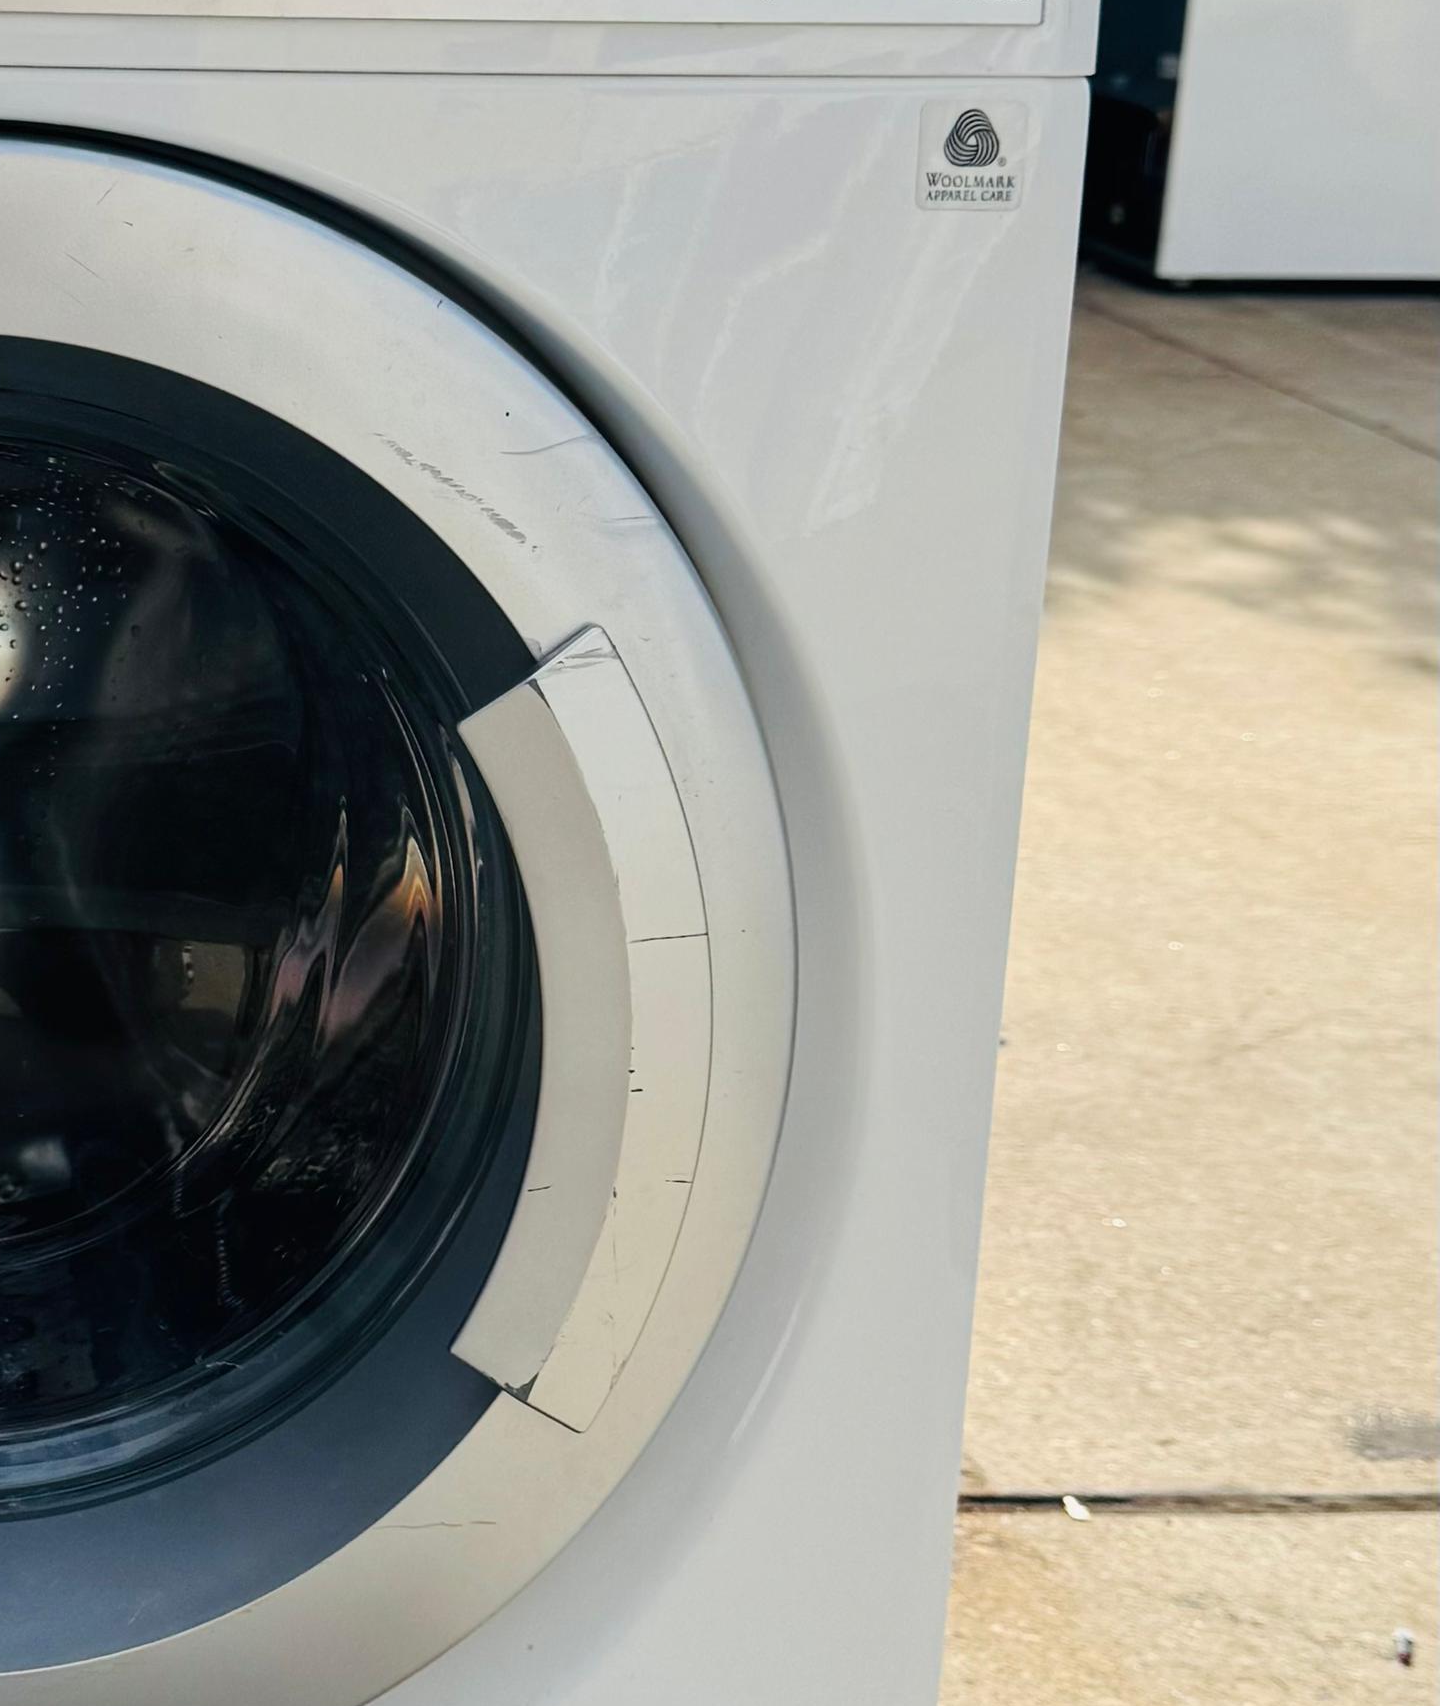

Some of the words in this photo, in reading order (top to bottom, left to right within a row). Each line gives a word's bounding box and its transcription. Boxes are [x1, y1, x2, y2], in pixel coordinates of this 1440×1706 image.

[926, 172, 1015, 188] WOOLMARK
[926, 190, 976, 201] APPAREL
[981, 191, 1012, 201] CARE
